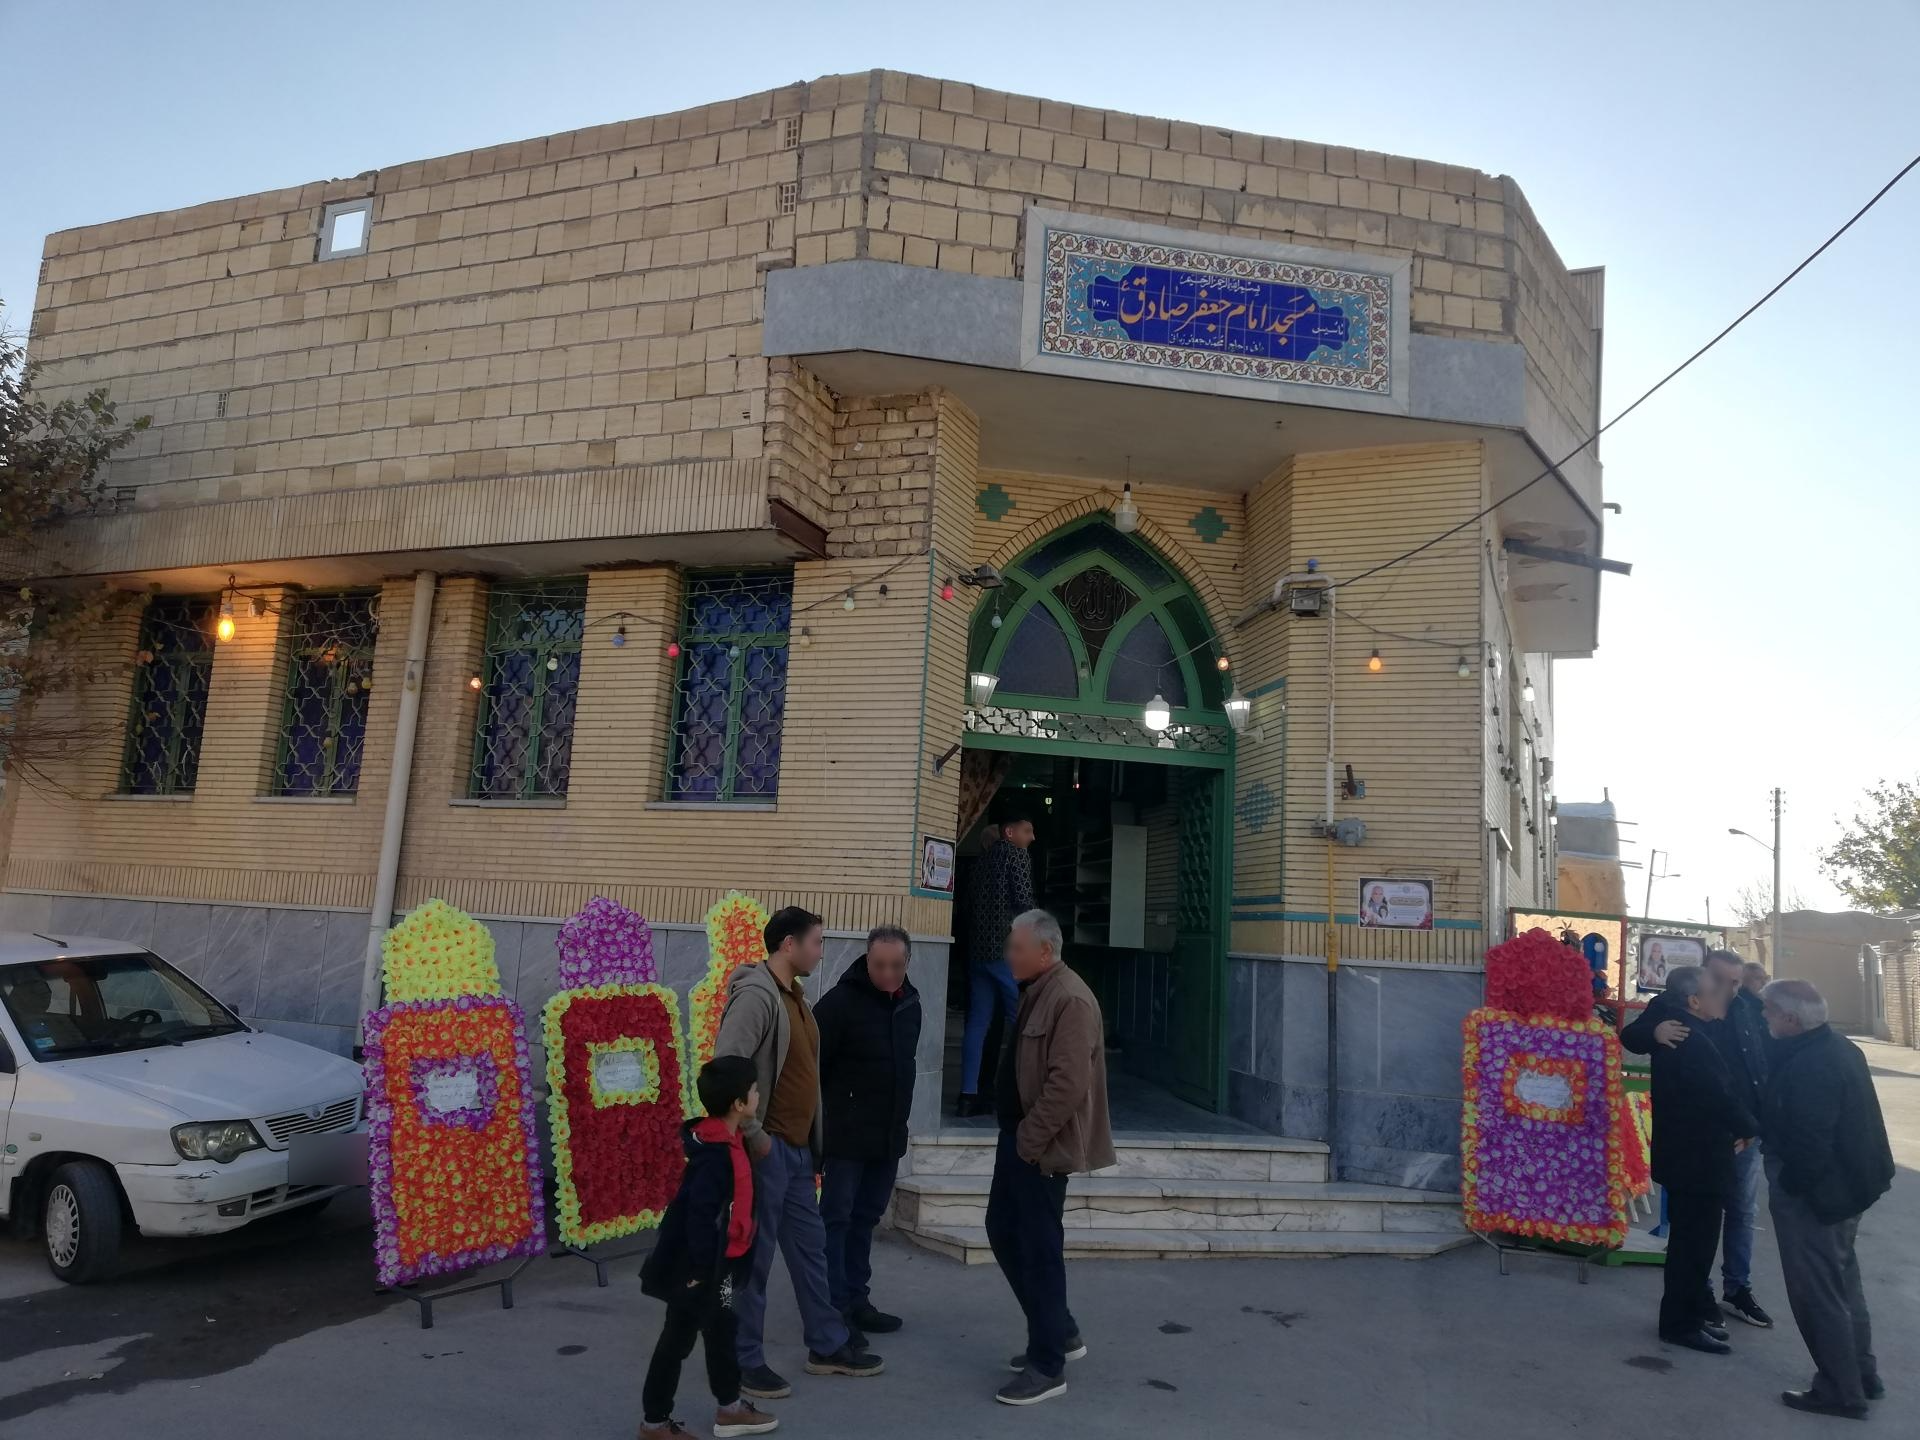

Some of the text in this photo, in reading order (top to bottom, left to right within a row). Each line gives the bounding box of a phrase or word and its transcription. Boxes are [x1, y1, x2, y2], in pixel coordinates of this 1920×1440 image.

[1120, 277, 1188, 324] صادق
[1174, 290, 1232, 333] جعفر
[1265, 295, 1315, 345] مسجد
[1224, 300, 1267, 351] امام
